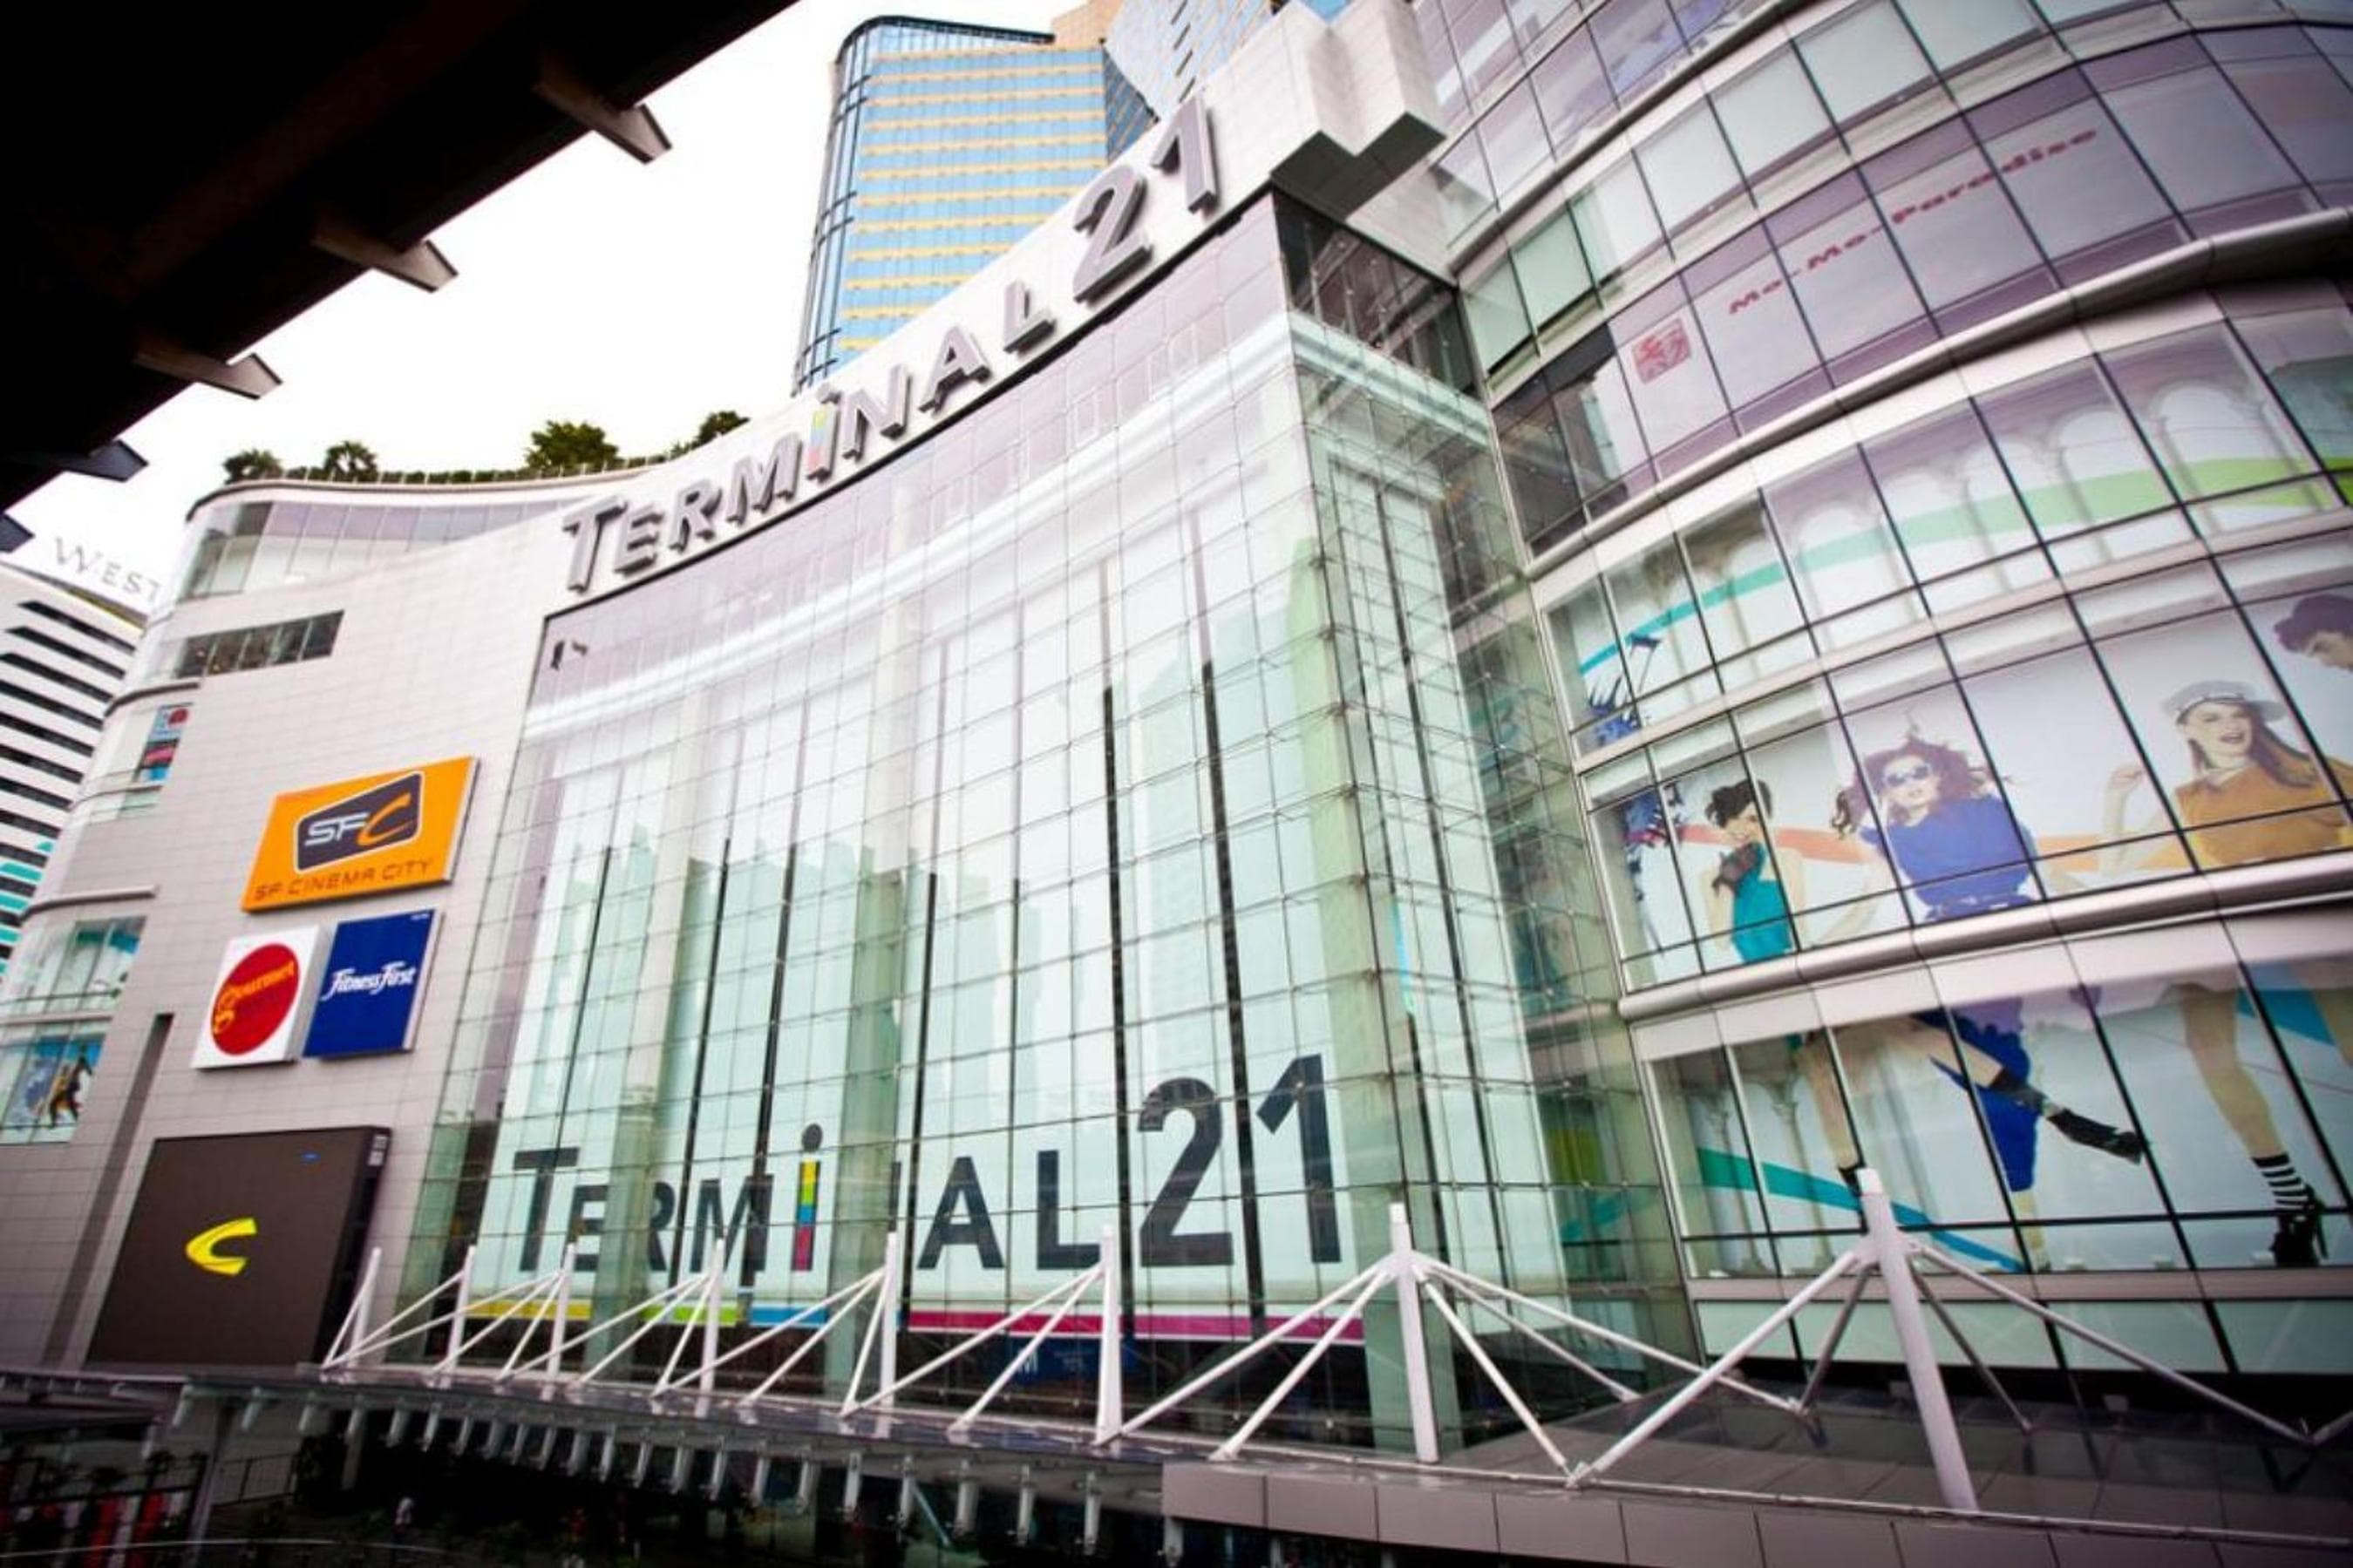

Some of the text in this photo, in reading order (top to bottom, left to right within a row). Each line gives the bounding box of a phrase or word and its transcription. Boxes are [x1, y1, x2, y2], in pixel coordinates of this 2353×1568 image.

[1072, 93, 1221, 307] 21
[255, 858, 431, 901] SF CINEMA CITY
[305, 791, 413, 846] SFC
[513, 1053, 1342, 1272] TERMiAL 21
